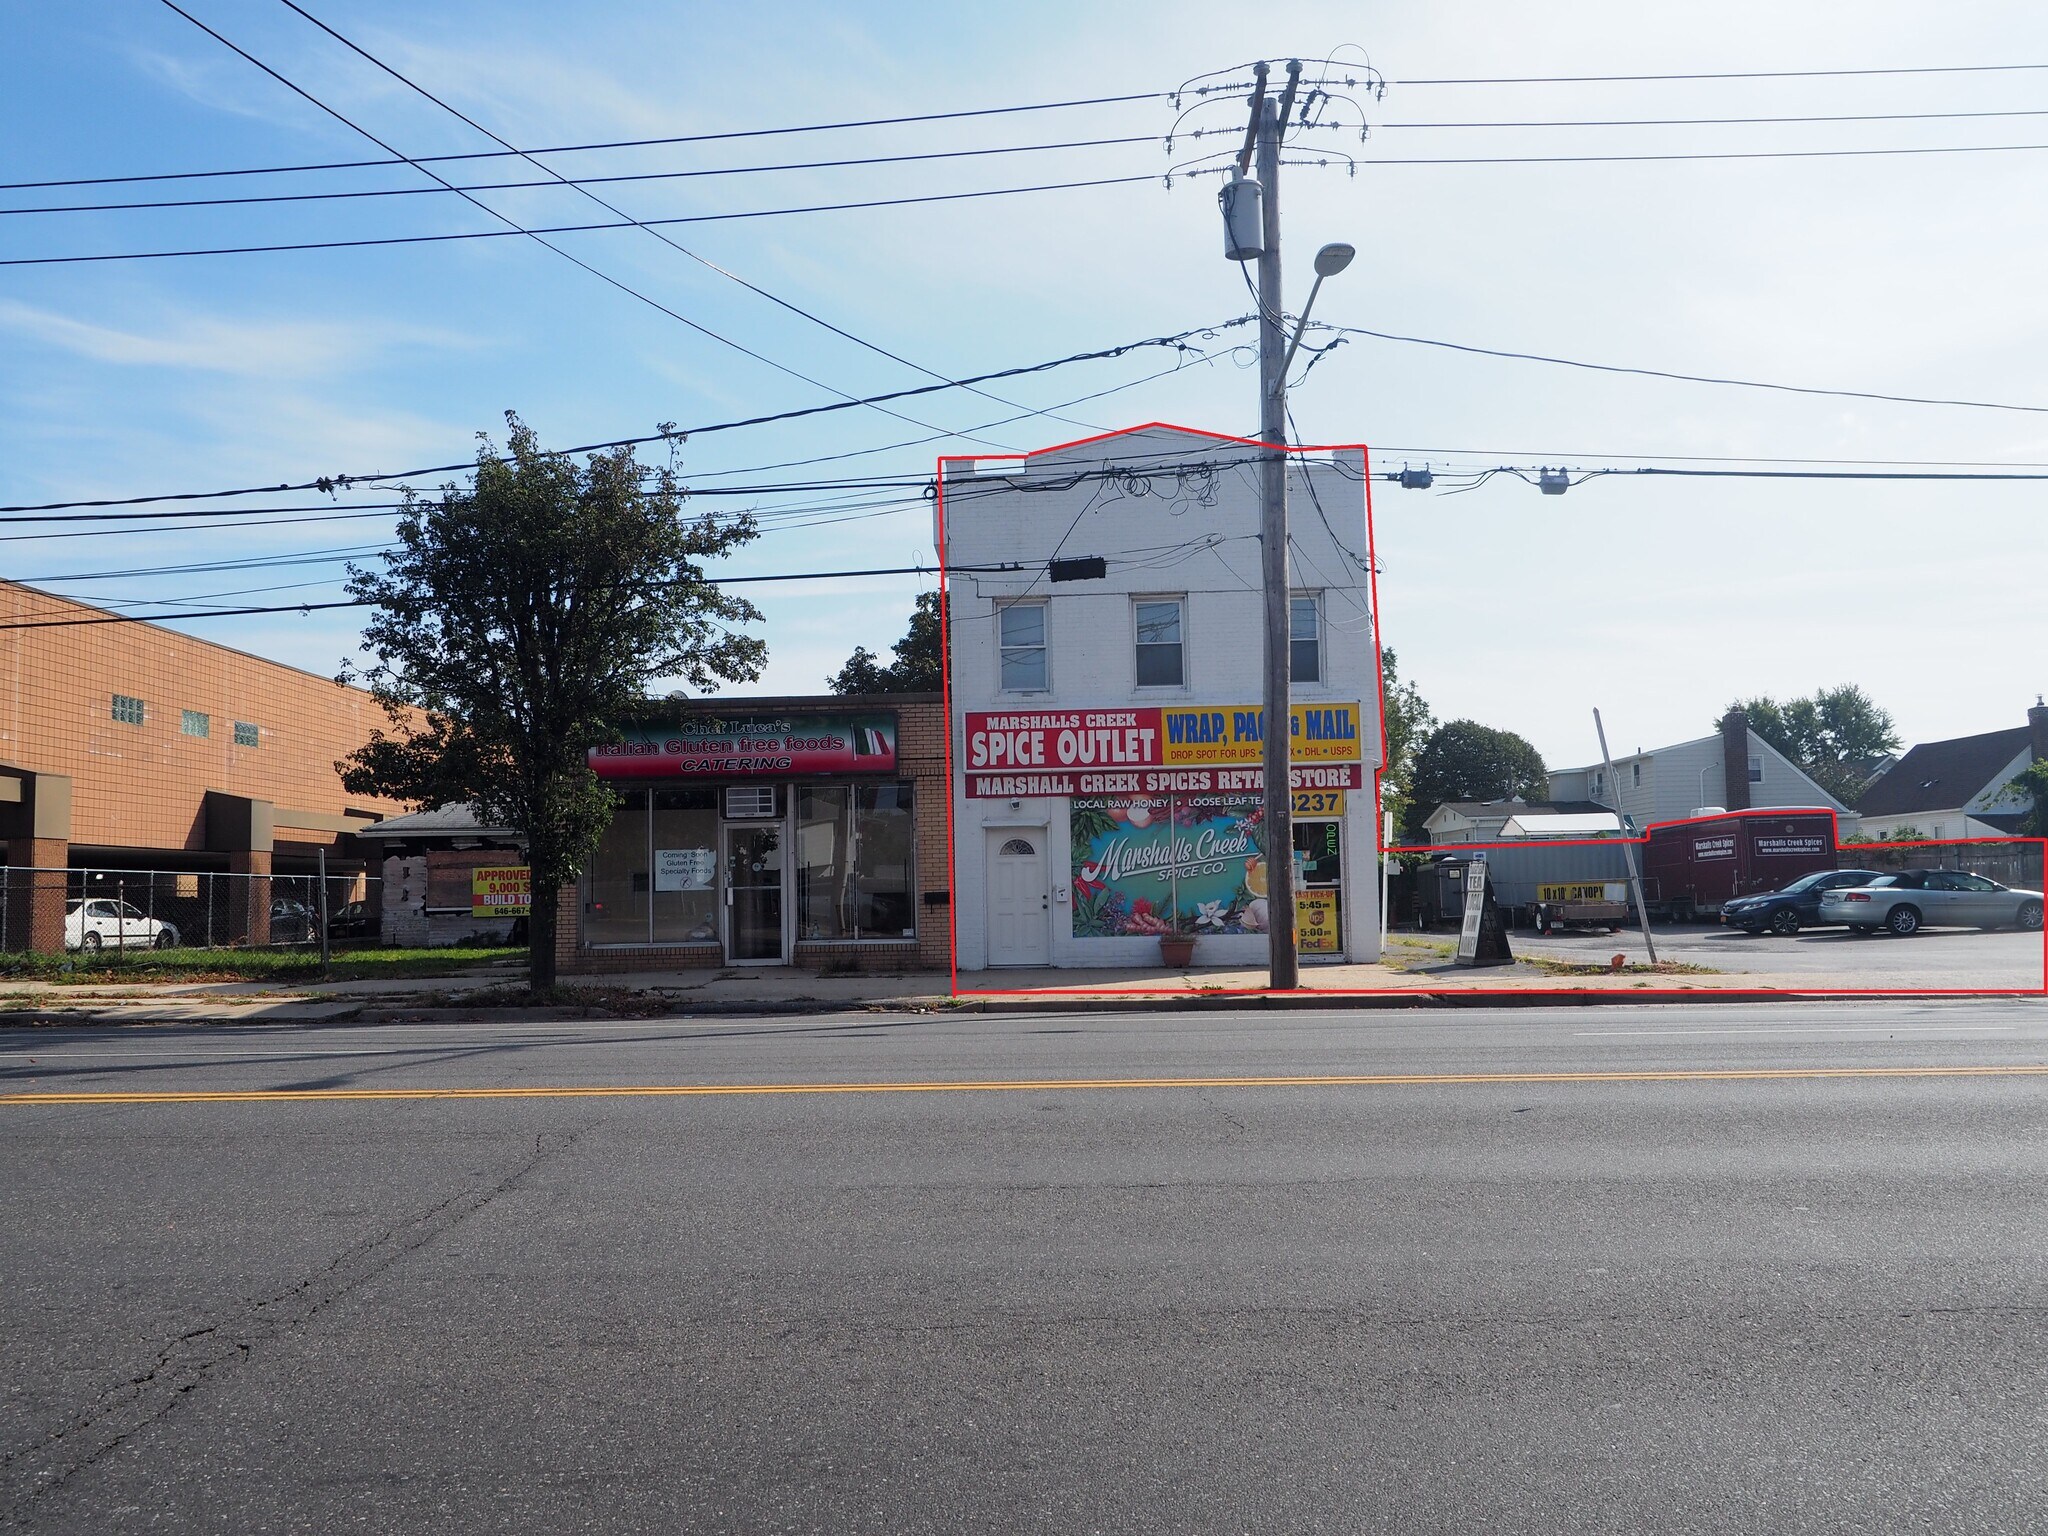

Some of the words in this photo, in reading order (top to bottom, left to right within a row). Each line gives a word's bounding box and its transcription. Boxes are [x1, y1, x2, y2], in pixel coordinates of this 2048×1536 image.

[730, 719, 791, 734] Luca's
[987, 714, 1080, 731] MARSHALLS
[1086, 713, 1137, 728] CREEK
[1166, 712, 1228, 747] WRAP,
[1233, 711, 1264, 742] PA
[1305, 709, 1355, 740] MAIL
[663, 738, 734, 755] Gluten
[738, 736, 781, 753] free
[784, 733, 845, 751] foods
[971, 730, 1045, 767] SPICE
[1057, 728, 1155, 765] OUTLET
[1170, 750, 1194, 760] DROP
[1196, 749, 1217, 759] SPOT
[1220, 748, 1237, 759] FOR
[1240, 748, 1256, 758] UPS
[1304, 747, 1321, 756] DHL
[1330, 745, 1353, 755] USPS
[680, 756, 792, 772] CATERING
[976, 775, 1074, 796] MARSHALL
[1080, 773, 1140, 793] CREEK
[1146, 771, 1211, 792] SPICES
[1217, 770, 1264, 790] RETA
[1290, 768, 1351, 788] STORE
[1073, 800, 1105, 809] LOCAL
[1107, 800, 1133, 809] RAW
[1133, 798, 1169, 808] HONEY
[1188, 797, 1222, 807] LOOSE
[1223, 796, 1247, 805] LEAF
[1325, 823, 1338, 856] OPEN
[1758, 839, 1786, 847] Marshalls
[1786, 838, 1804, 846] Creek
[1804, 838, 1823, 847] Spices
[662, 851, 688, 860] Coming
[690, 851, 708, 859] Soon
[1081, 837, 1193, 883] Marshalls
[1196, 828, 1249, 861] Creek
[689, 859, 705, 867] Free
[660, 867, 690, 875] Specialty
[691, 867, 712, 875] Foods
[1157, 865, 1199, 881] SPICE
[1202, 862, 1227, 876] CO.
[488, 882, 520, 894] 9,000
[1469, 876, 1482, 889] TEA
[483, 894, 515, 905] BUILD
[1311, 890, 1334, 898] PICK-UP
[1299, 900, 1322, 909] 5:45
[1300, 928, 1323, 937] 5:00
[1300, 938, 1334, 949] FedEx
